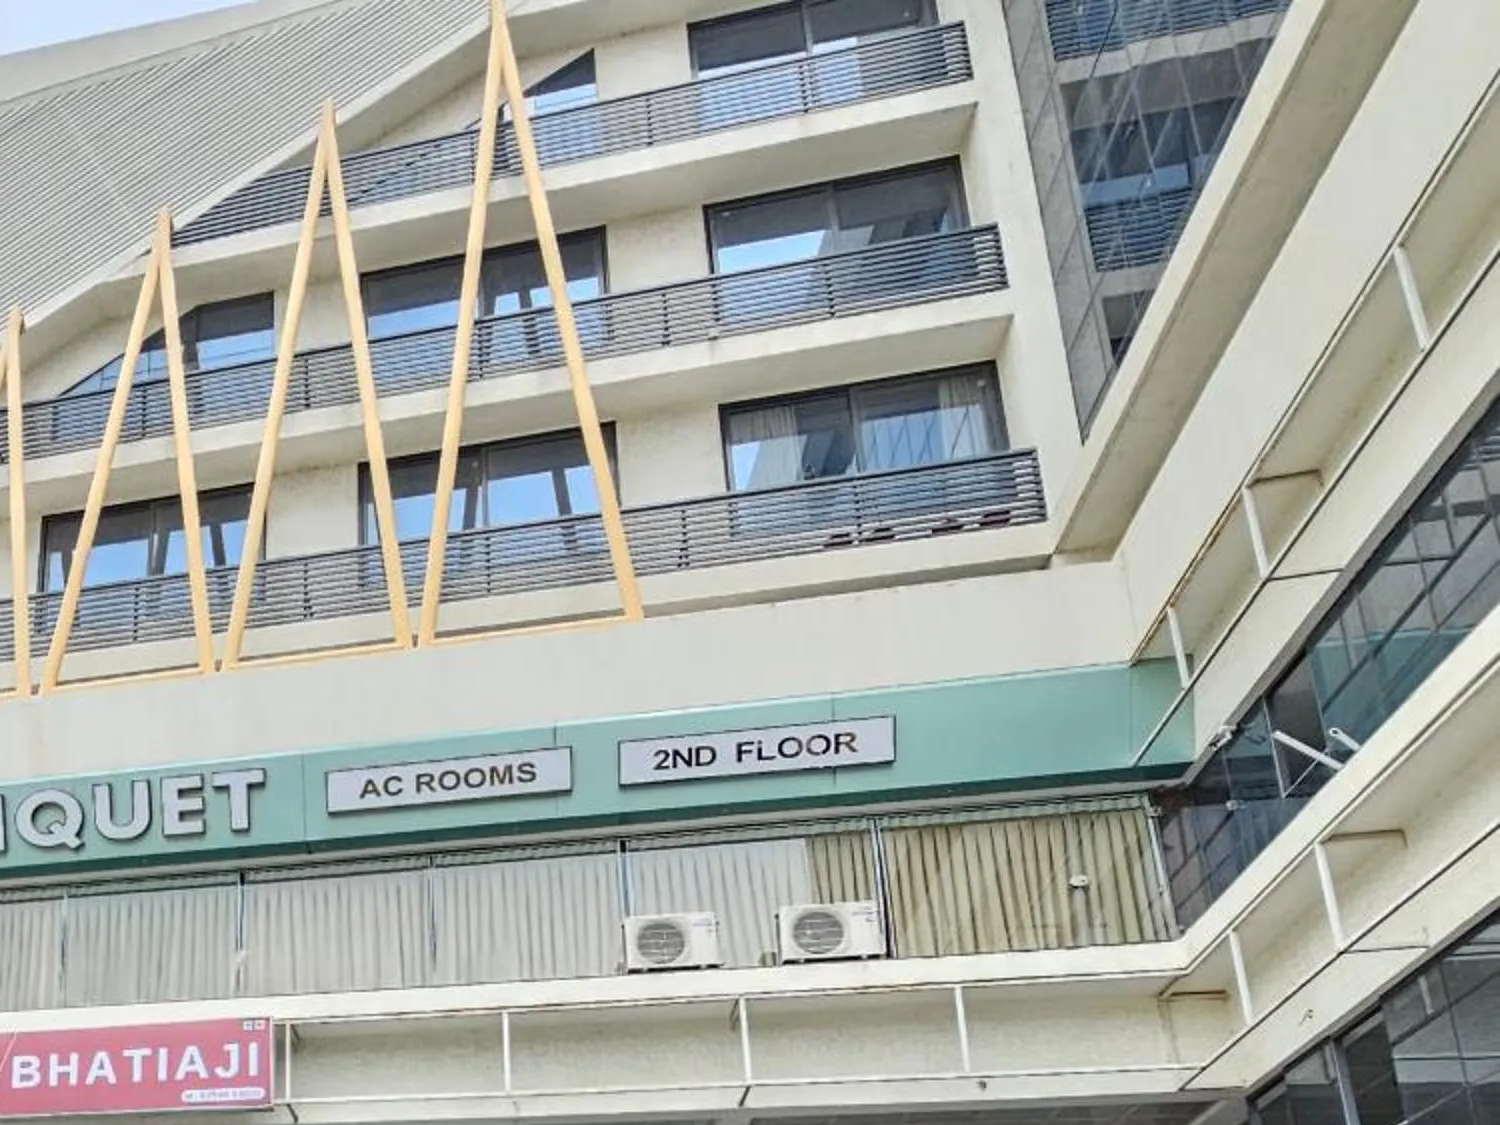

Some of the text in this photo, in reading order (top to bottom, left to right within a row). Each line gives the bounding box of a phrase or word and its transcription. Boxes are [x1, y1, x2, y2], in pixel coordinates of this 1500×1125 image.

[653, 731, 859, 772] 2ND FLOOR
[360, 762, 538, 800] AC ROOMS
[11, 1040, 260, 1090] BHATIAJI
